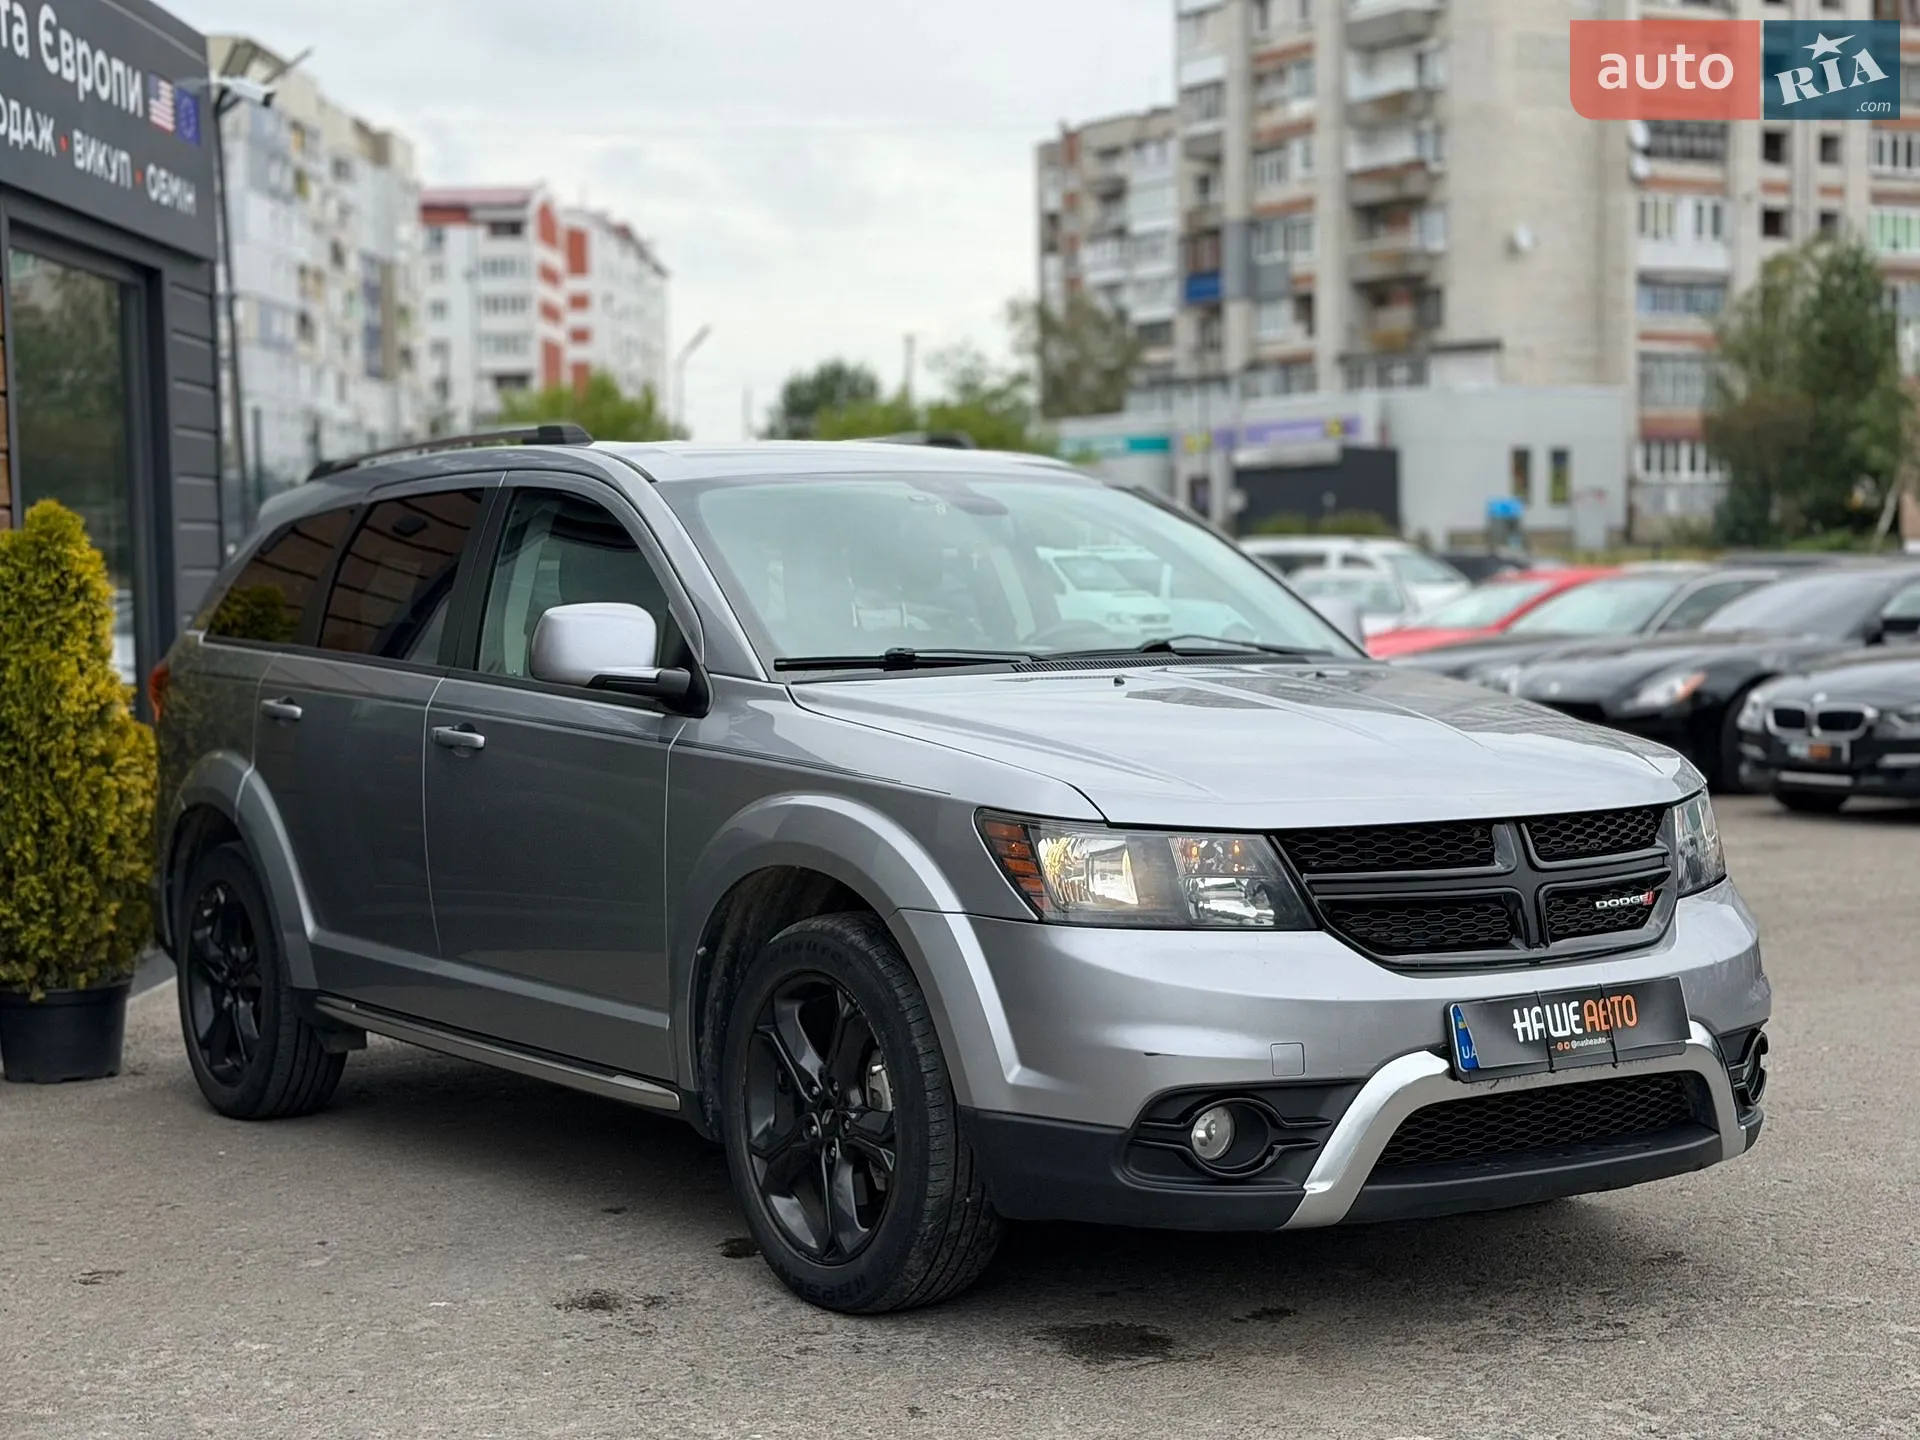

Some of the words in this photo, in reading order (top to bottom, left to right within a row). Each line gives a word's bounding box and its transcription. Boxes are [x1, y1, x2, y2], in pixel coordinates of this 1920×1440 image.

[38, 4, 144, 118] Європи
[72, 129, 132, 190] ВИКУП
[1595, 892, 1650, 910] DODGE
